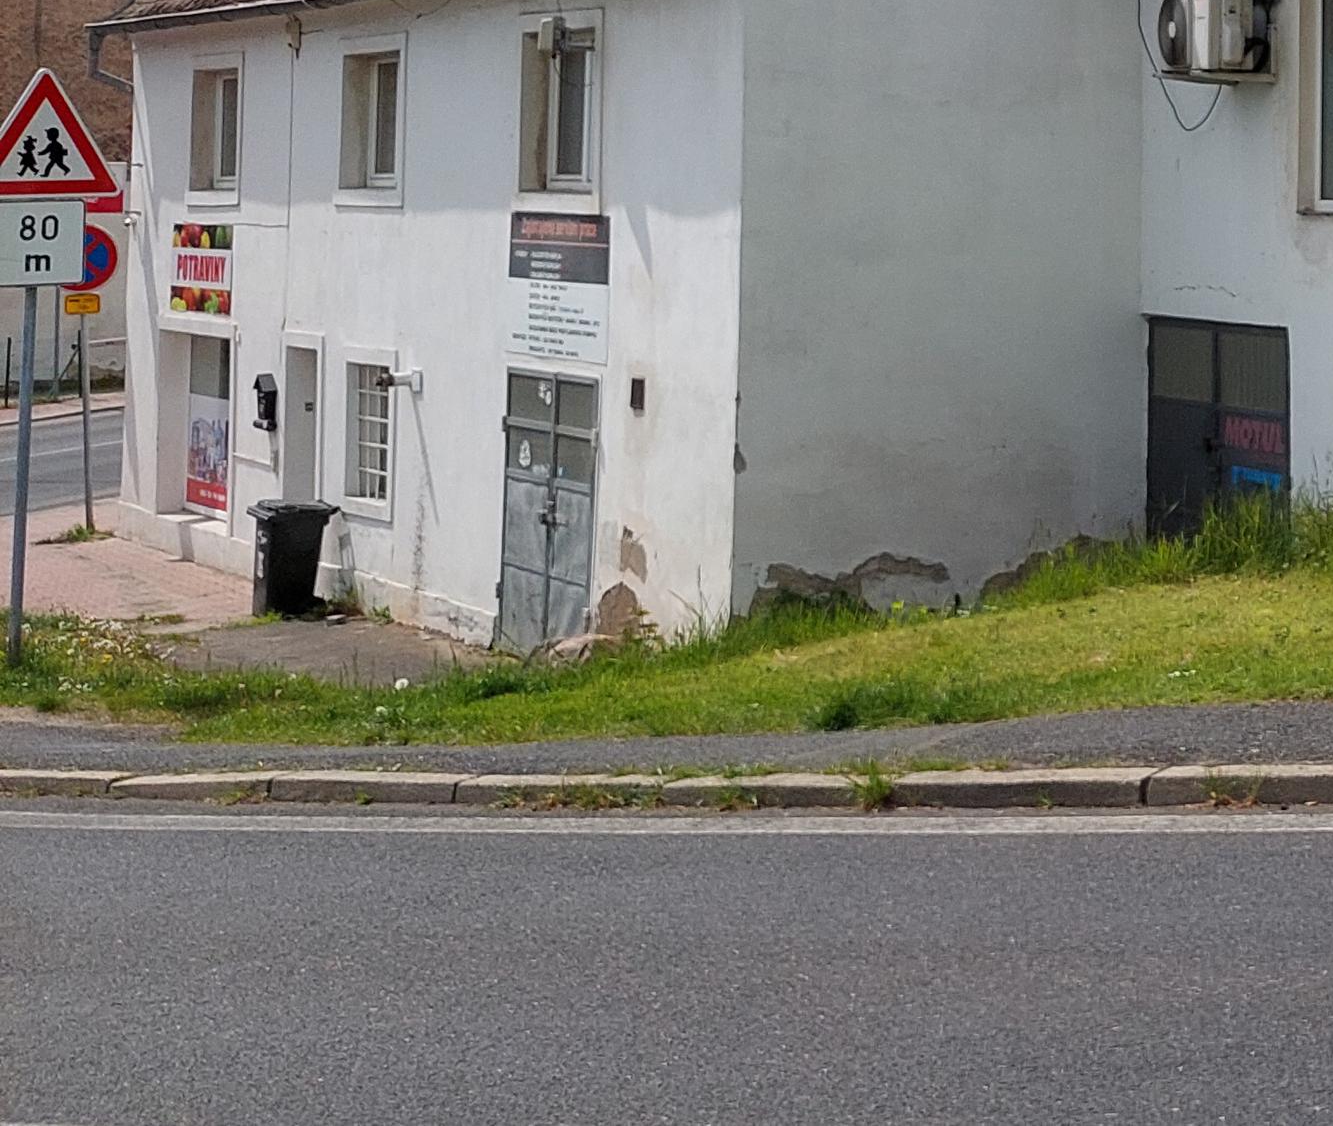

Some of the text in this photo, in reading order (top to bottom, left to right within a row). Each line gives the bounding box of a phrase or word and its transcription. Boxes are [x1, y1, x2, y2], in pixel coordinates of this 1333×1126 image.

[19, 215, 59, 241] 80
[24, 254, 51, 272] m
[176, 254, 226, 283] POTRAVINY
